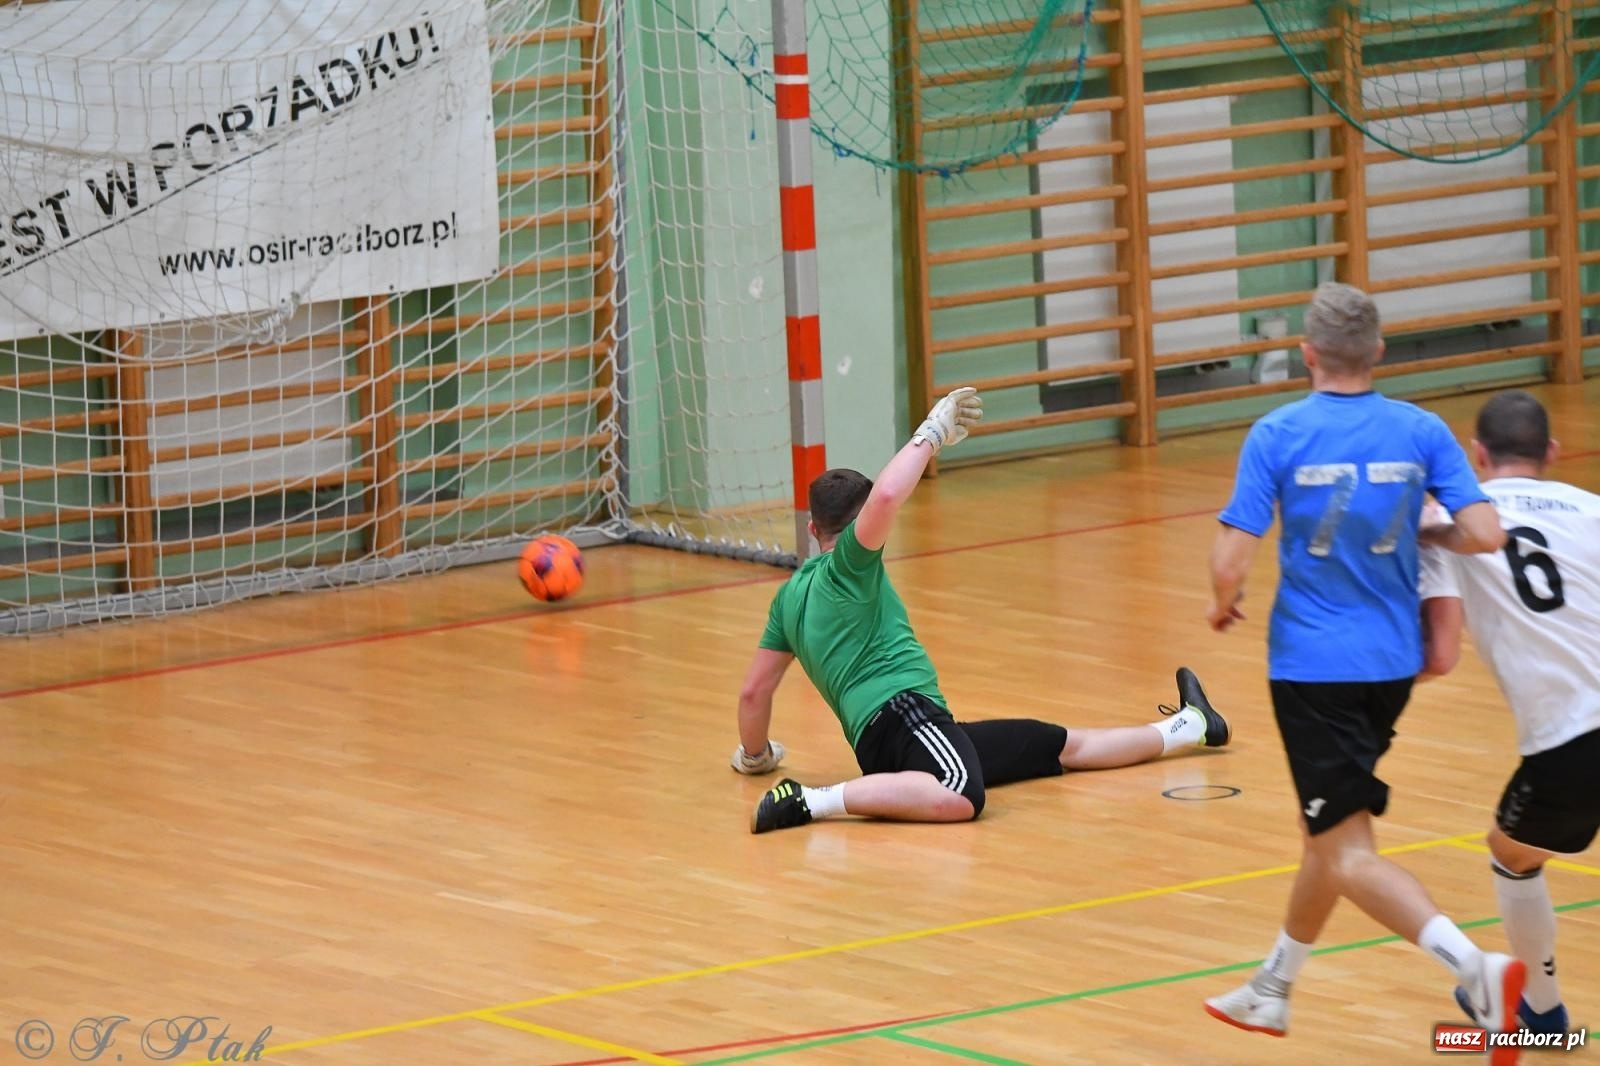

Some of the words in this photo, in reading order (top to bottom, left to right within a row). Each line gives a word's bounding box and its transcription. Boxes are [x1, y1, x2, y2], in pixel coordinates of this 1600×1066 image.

[85, 162, 139, 219] W
[1294, 461, 1425, 557] 77
[1503, 526, 1564, 613] 6
